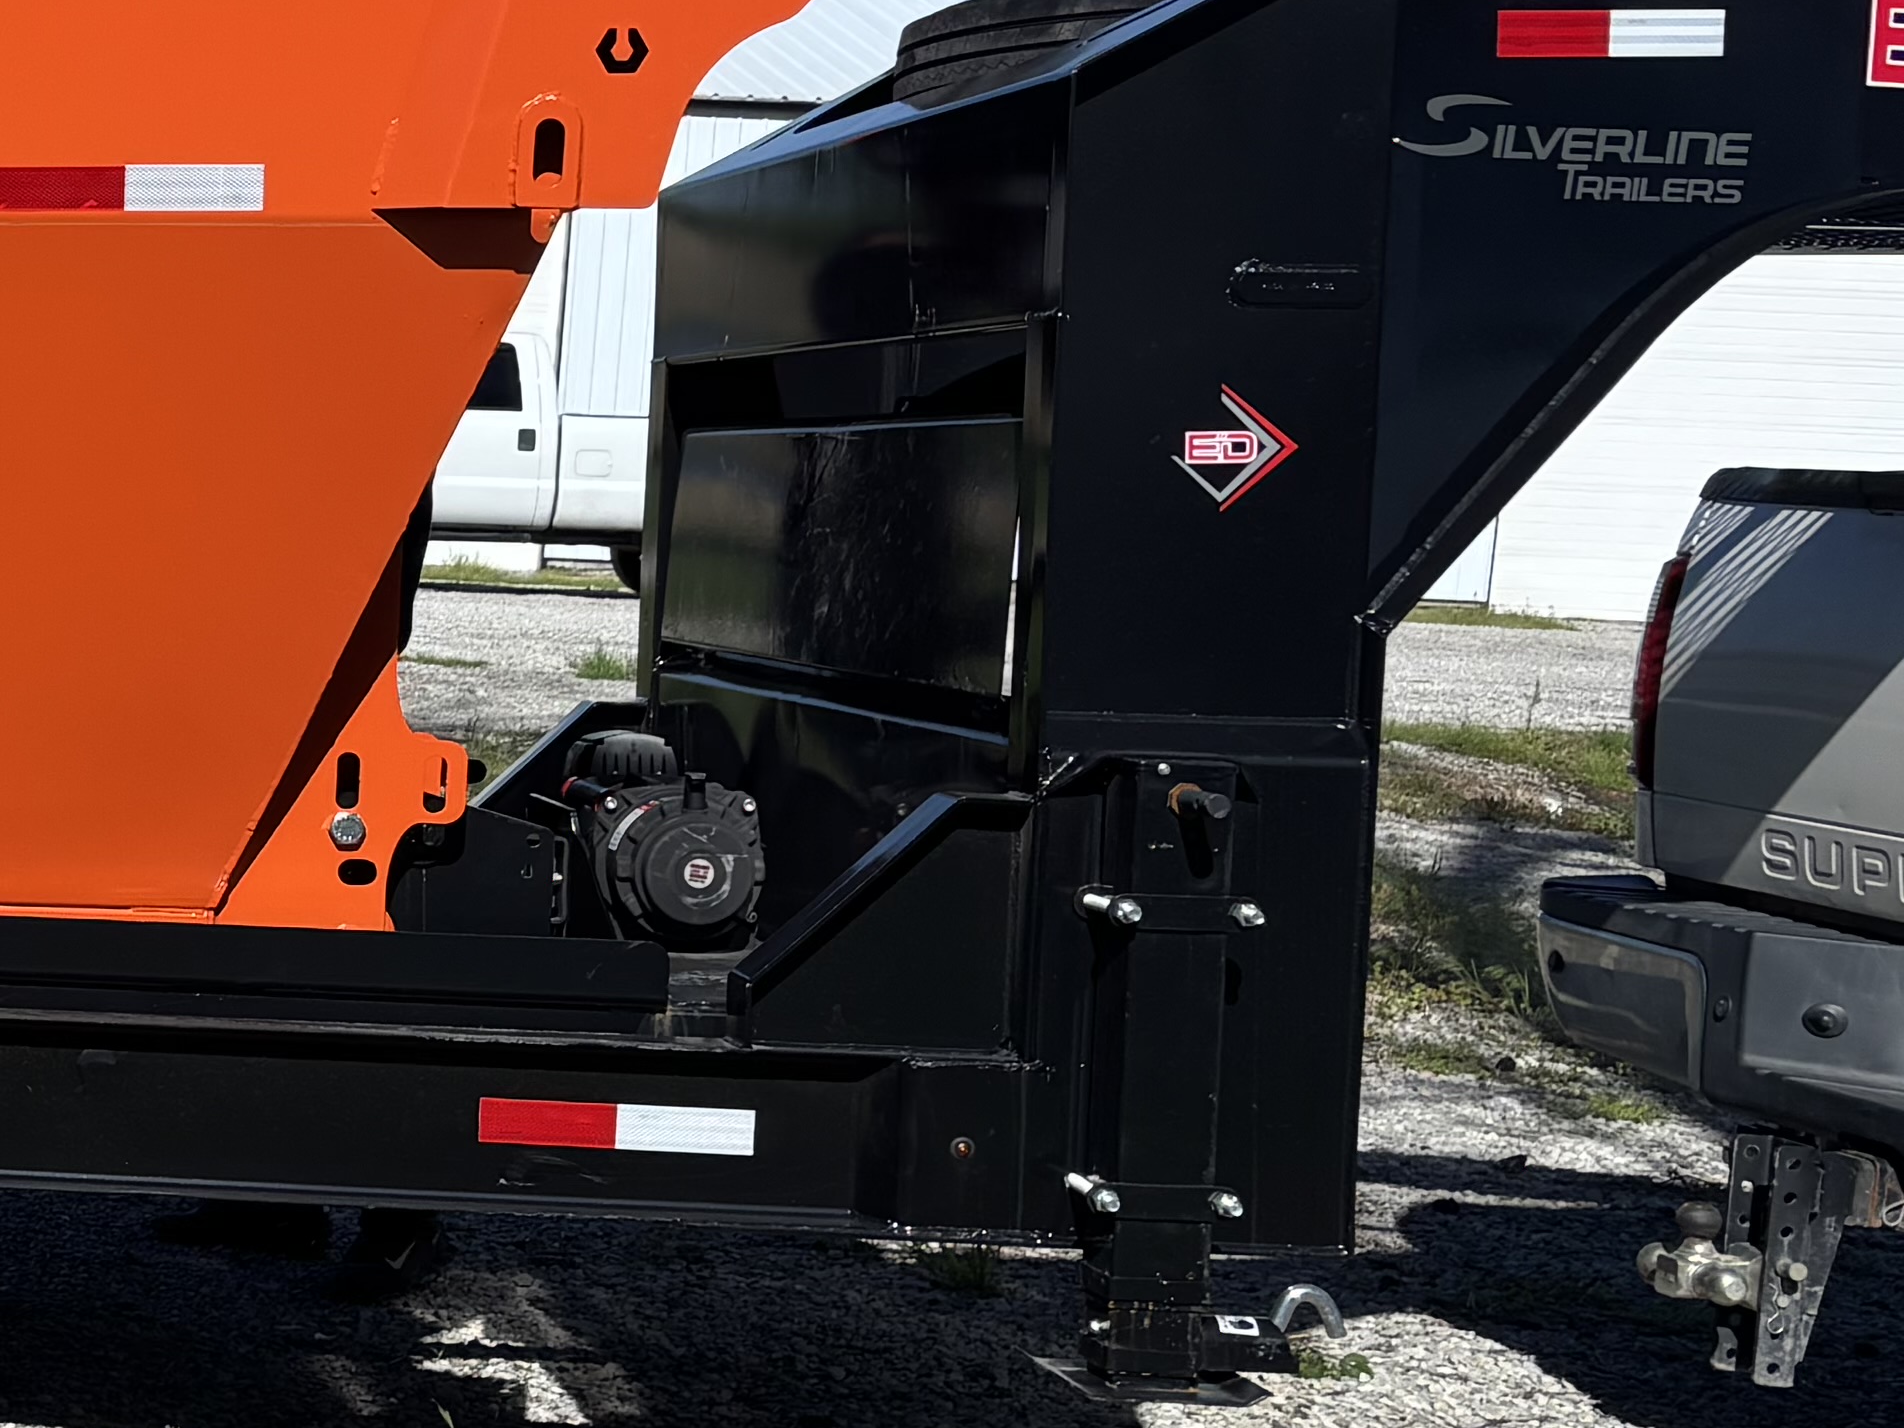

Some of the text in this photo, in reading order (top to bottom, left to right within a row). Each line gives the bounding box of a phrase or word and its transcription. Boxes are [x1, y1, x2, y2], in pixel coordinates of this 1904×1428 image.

[1393, 93, 1753, 167] SILVERLINE
[1557, 163, 1745, 204] TRAILERS
[1760, 828, 1904, 904] SUP
